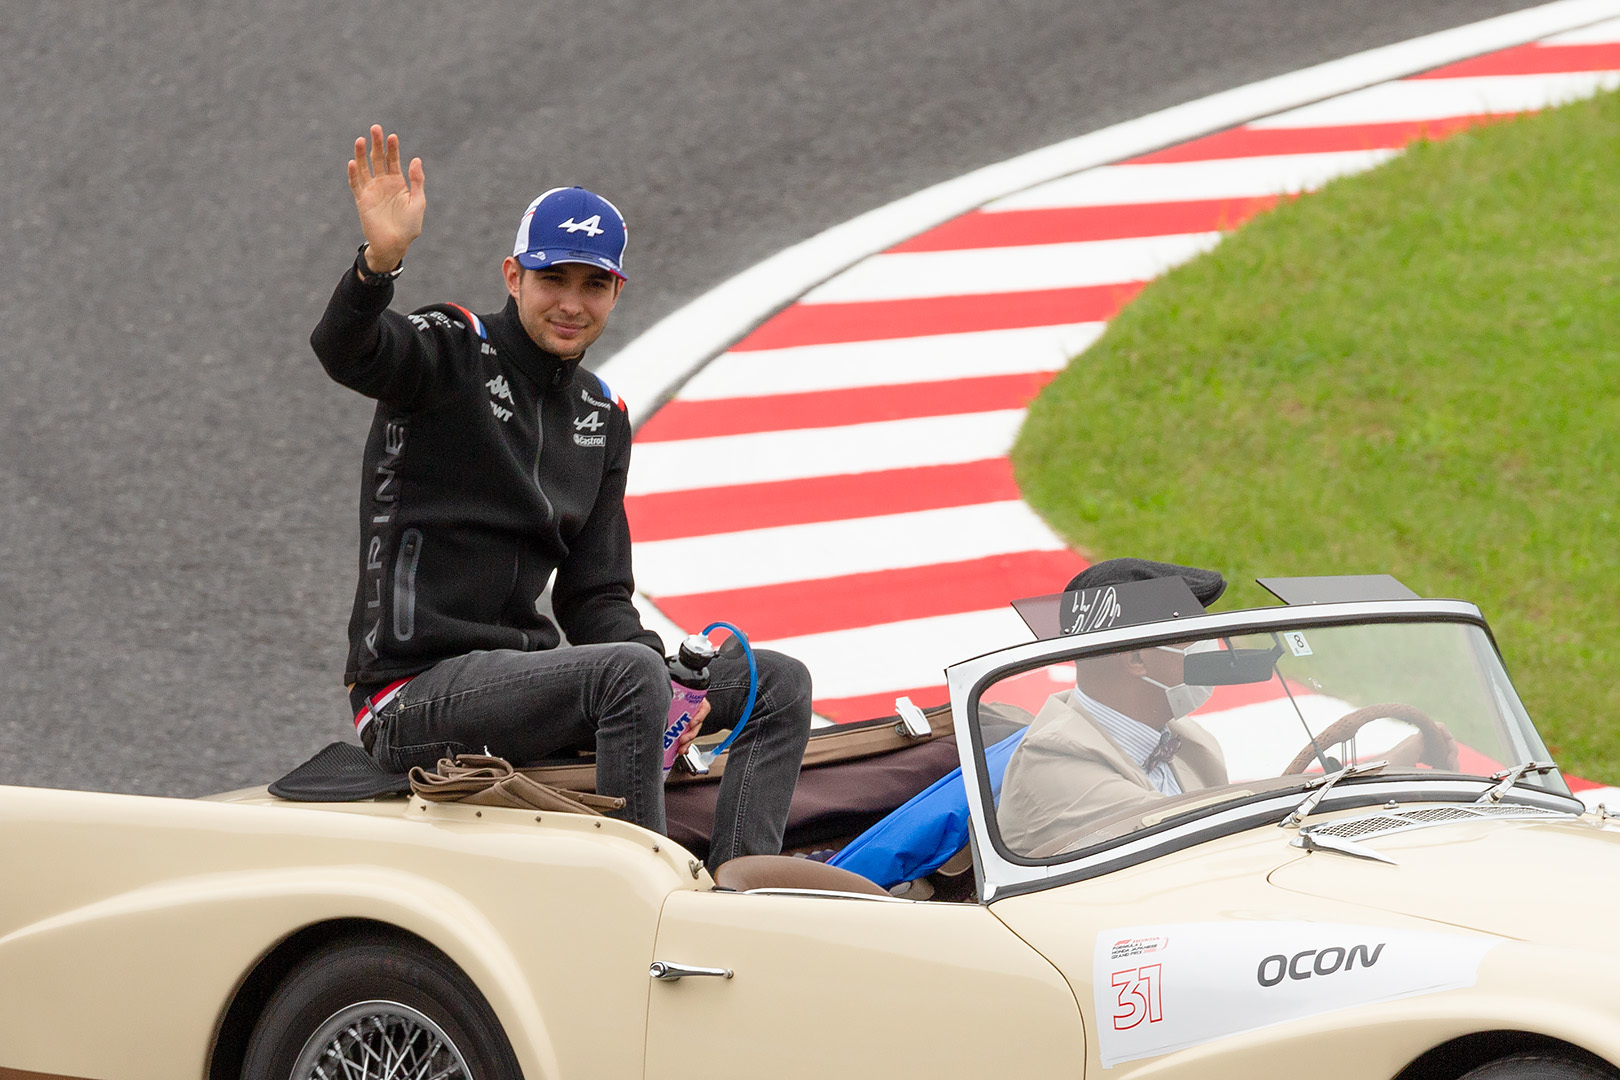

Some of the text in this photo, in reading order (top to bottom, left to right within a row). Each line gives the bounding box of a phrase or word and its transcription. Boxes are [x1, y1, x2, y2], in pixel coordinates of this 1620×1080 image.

[489, 400, 514, 422] WT
[365, 422, 404, 660] ALPINE
[663, 712, 692, 750] BWT
[1257, 943, 1386, 988] OCON
[1111, 963, 1163, 1030] 31
